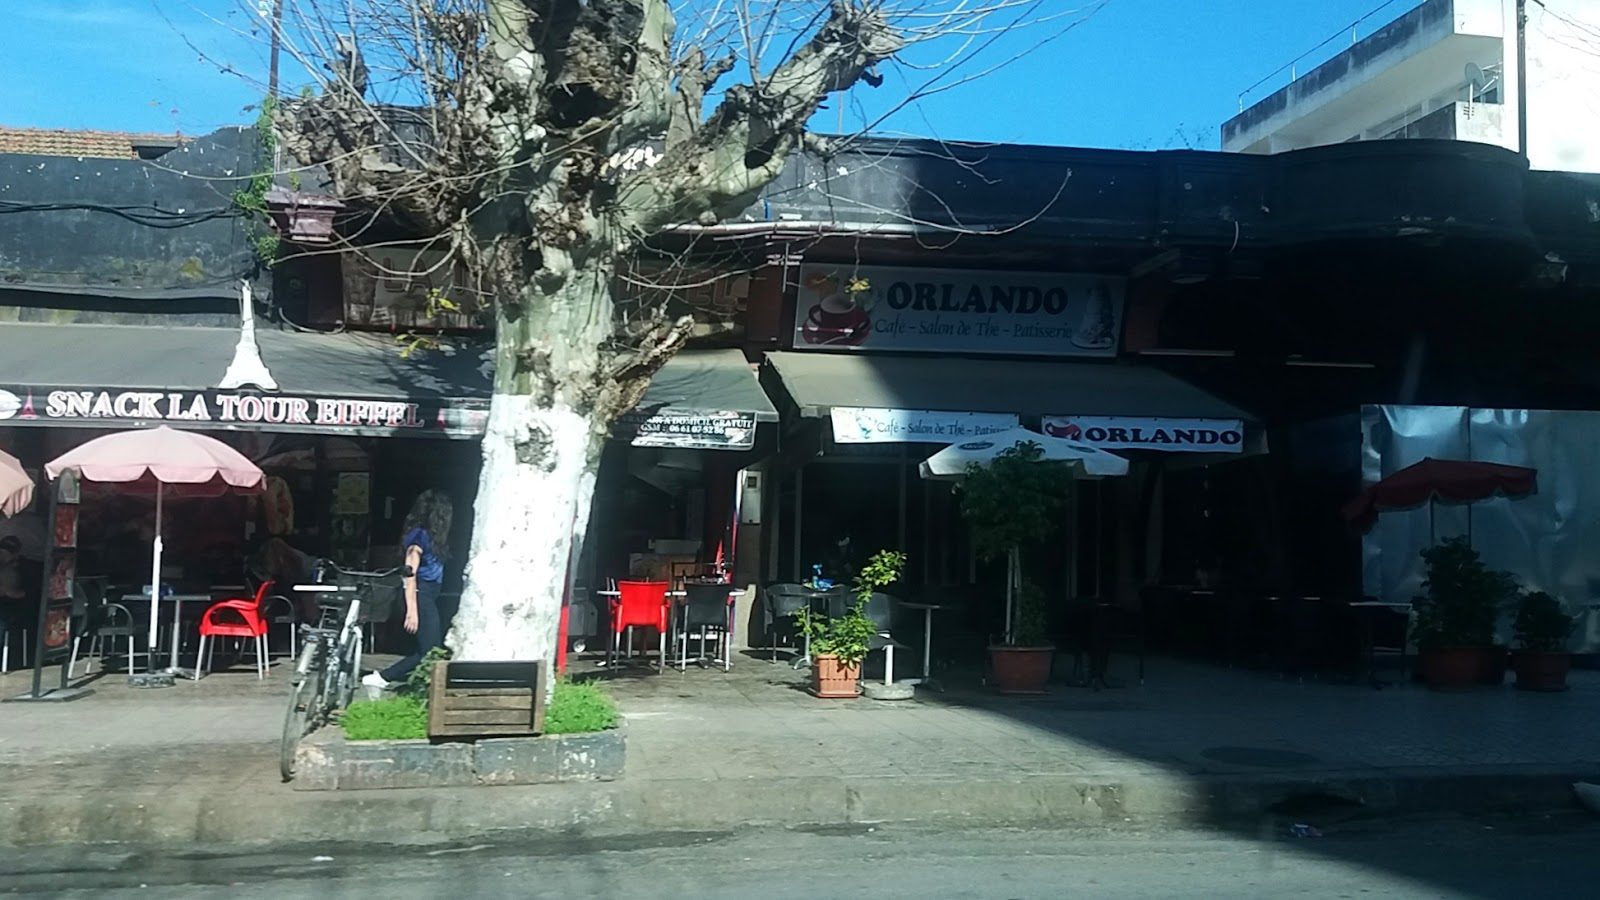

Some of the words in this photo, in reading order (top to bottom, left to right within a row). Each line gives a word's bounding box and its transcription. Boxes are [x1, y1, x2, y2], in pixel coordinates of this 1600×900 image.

[887, 281, 1068, 316] ORLANDO
[875, 312, 905, 338] Café
[920, 314, 954, 335] Salon
[957, 320, 971, 336] de
[45, 391, 164, 418] SNACK
[166, 393, 212, 421] LA
[216, 394, 311, 424] TOUR
[314, 399, 425, 428] EIFFEL
[712, 418, 753, 428] GRATUIT
[876, 418, 899, 436] Café
[907, 419, 933, 434] Salon
[934, 423, 945, 434] de
[1085, 427, 1241, 445] ORLANDO
